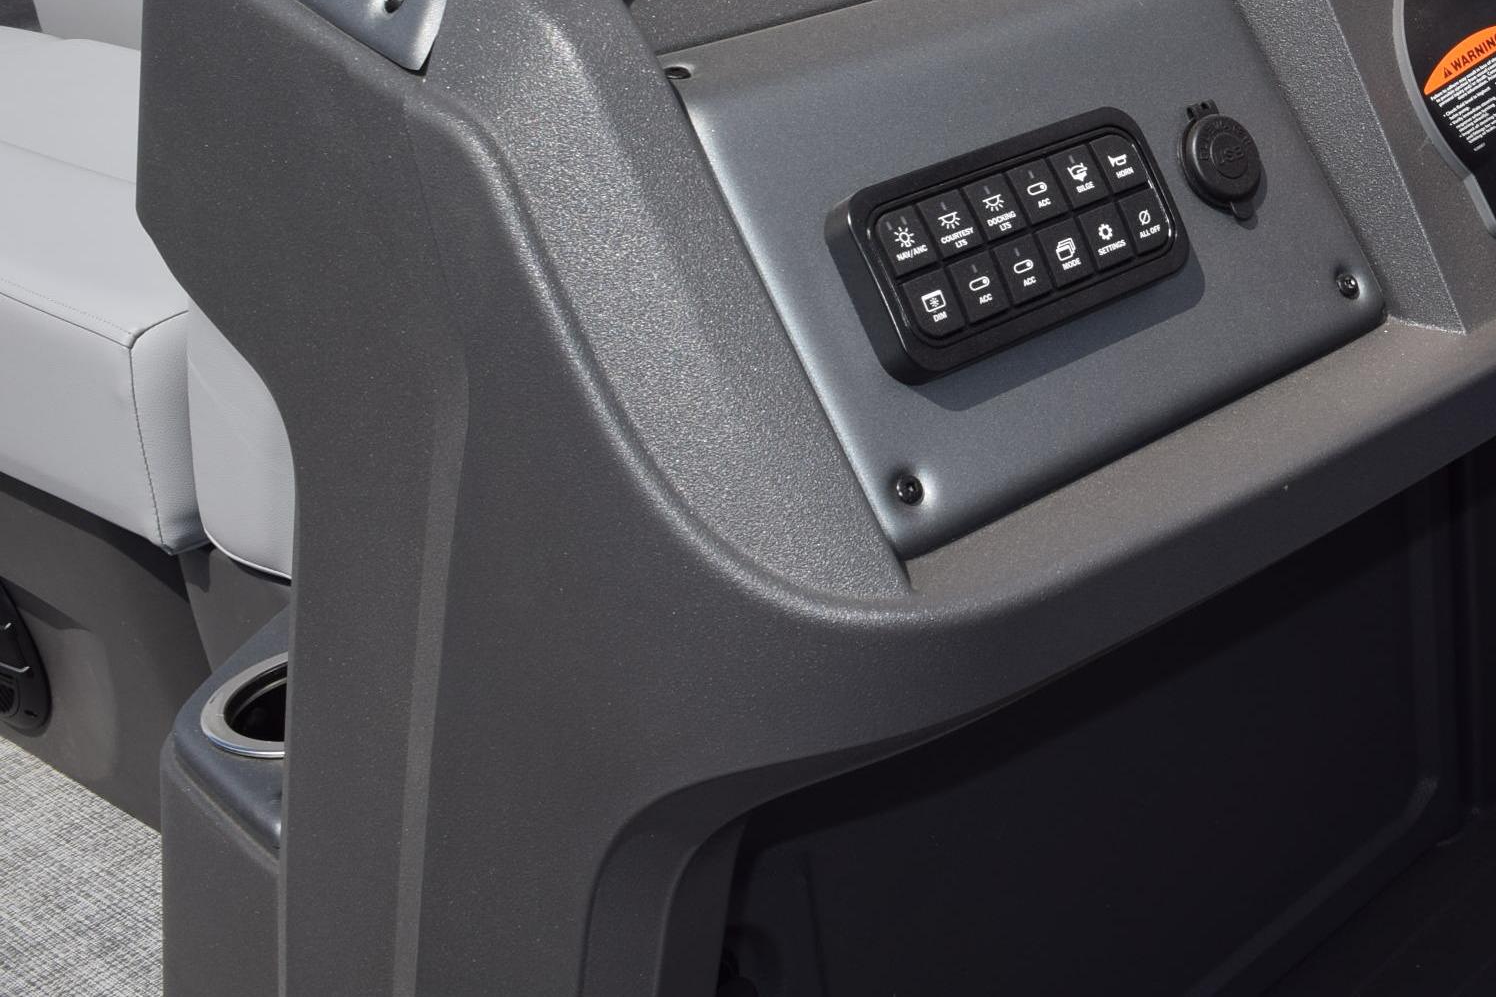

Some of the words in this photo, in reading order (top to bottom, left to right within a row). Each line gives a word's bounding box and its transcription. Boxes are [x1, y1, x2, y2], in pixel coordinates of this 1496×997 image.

[1116, 167, 1134, 179] HORN
[1076, 181, 1095, 193] BILGE
[1038, 198, 1051, 208] ACC
[987, 211, 1016, 227] DOCKING
[999, 222, 1012, 231] LTS
[1139, 229, 1151, 239] ALL
[1150, 224, 1161, 235] OFF
[940, 227, 974, 244] COURTESY
[955, 239, 968, 248] LTS
[1098, 239, 1126, 256] SETTINGS
[896, 245, 928, 262] NAV/ANC
[1062, 257, 1082, 271] MODE
[1023, 276, 1037, 287] ACC
[979, 293, 993, 305] ACC
[933, 311, 948, 322] DIM
